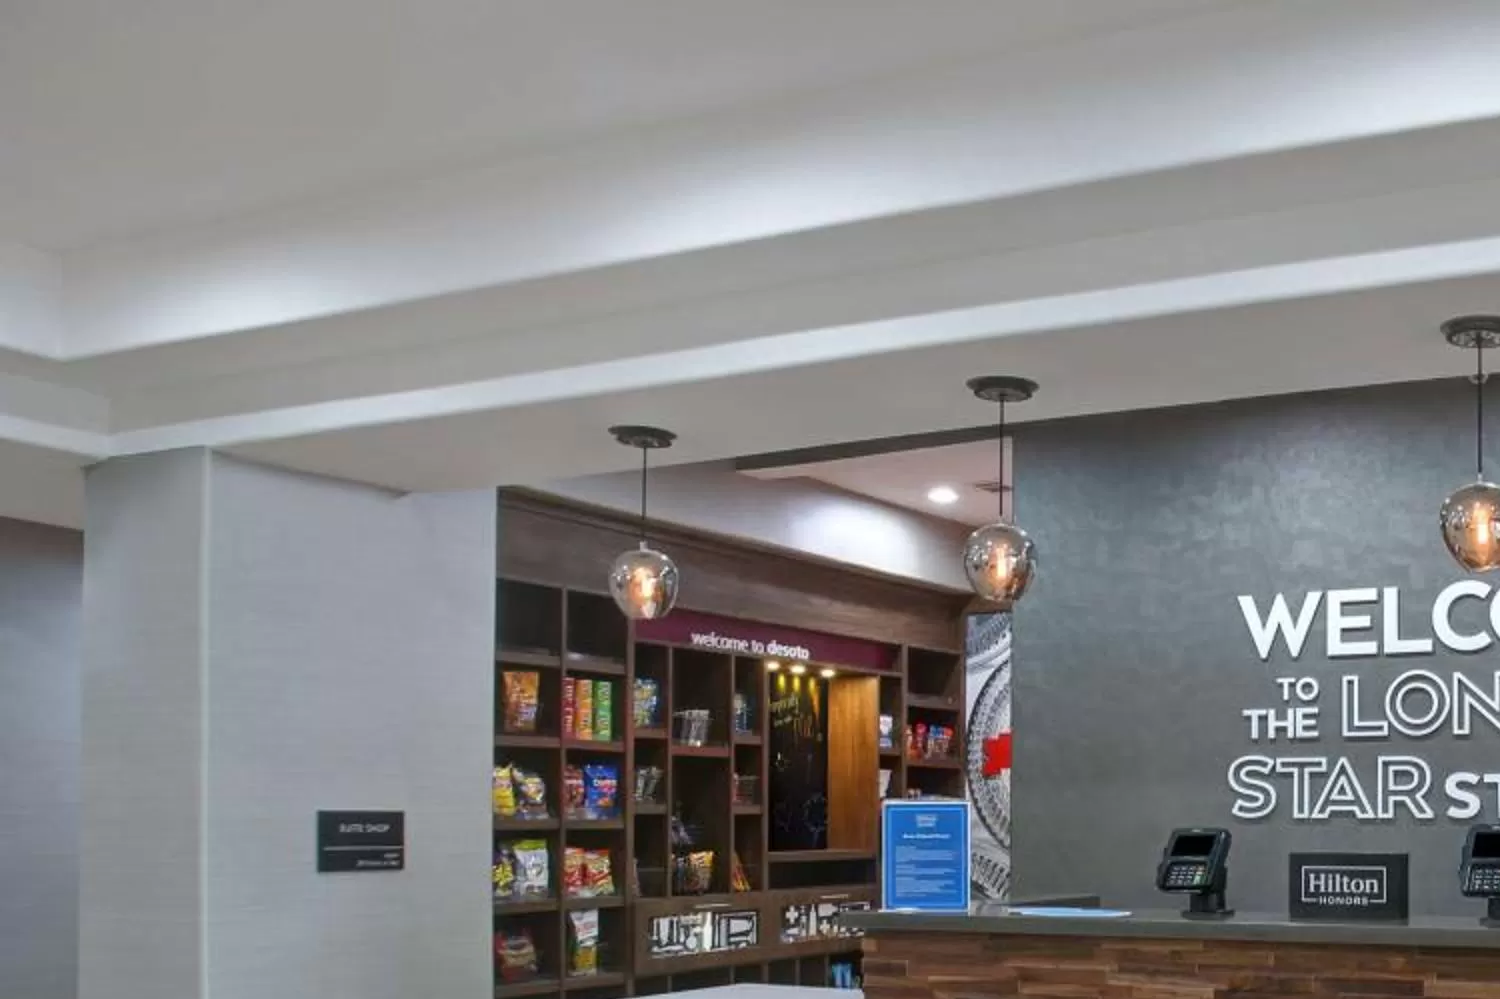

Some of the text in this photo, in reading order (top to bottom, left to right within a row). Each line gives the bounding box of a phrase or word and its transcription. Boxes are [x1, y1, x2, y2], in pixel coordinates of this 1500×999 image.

[691, 631, 810, 660] welcome to desoto
[1276, 677, 1319, 701] TO
[1243, 709, 1319, 740] THE
[1228, 755, 1434, 820] STAR
[1308, 873, 1379, 894] Hilton
